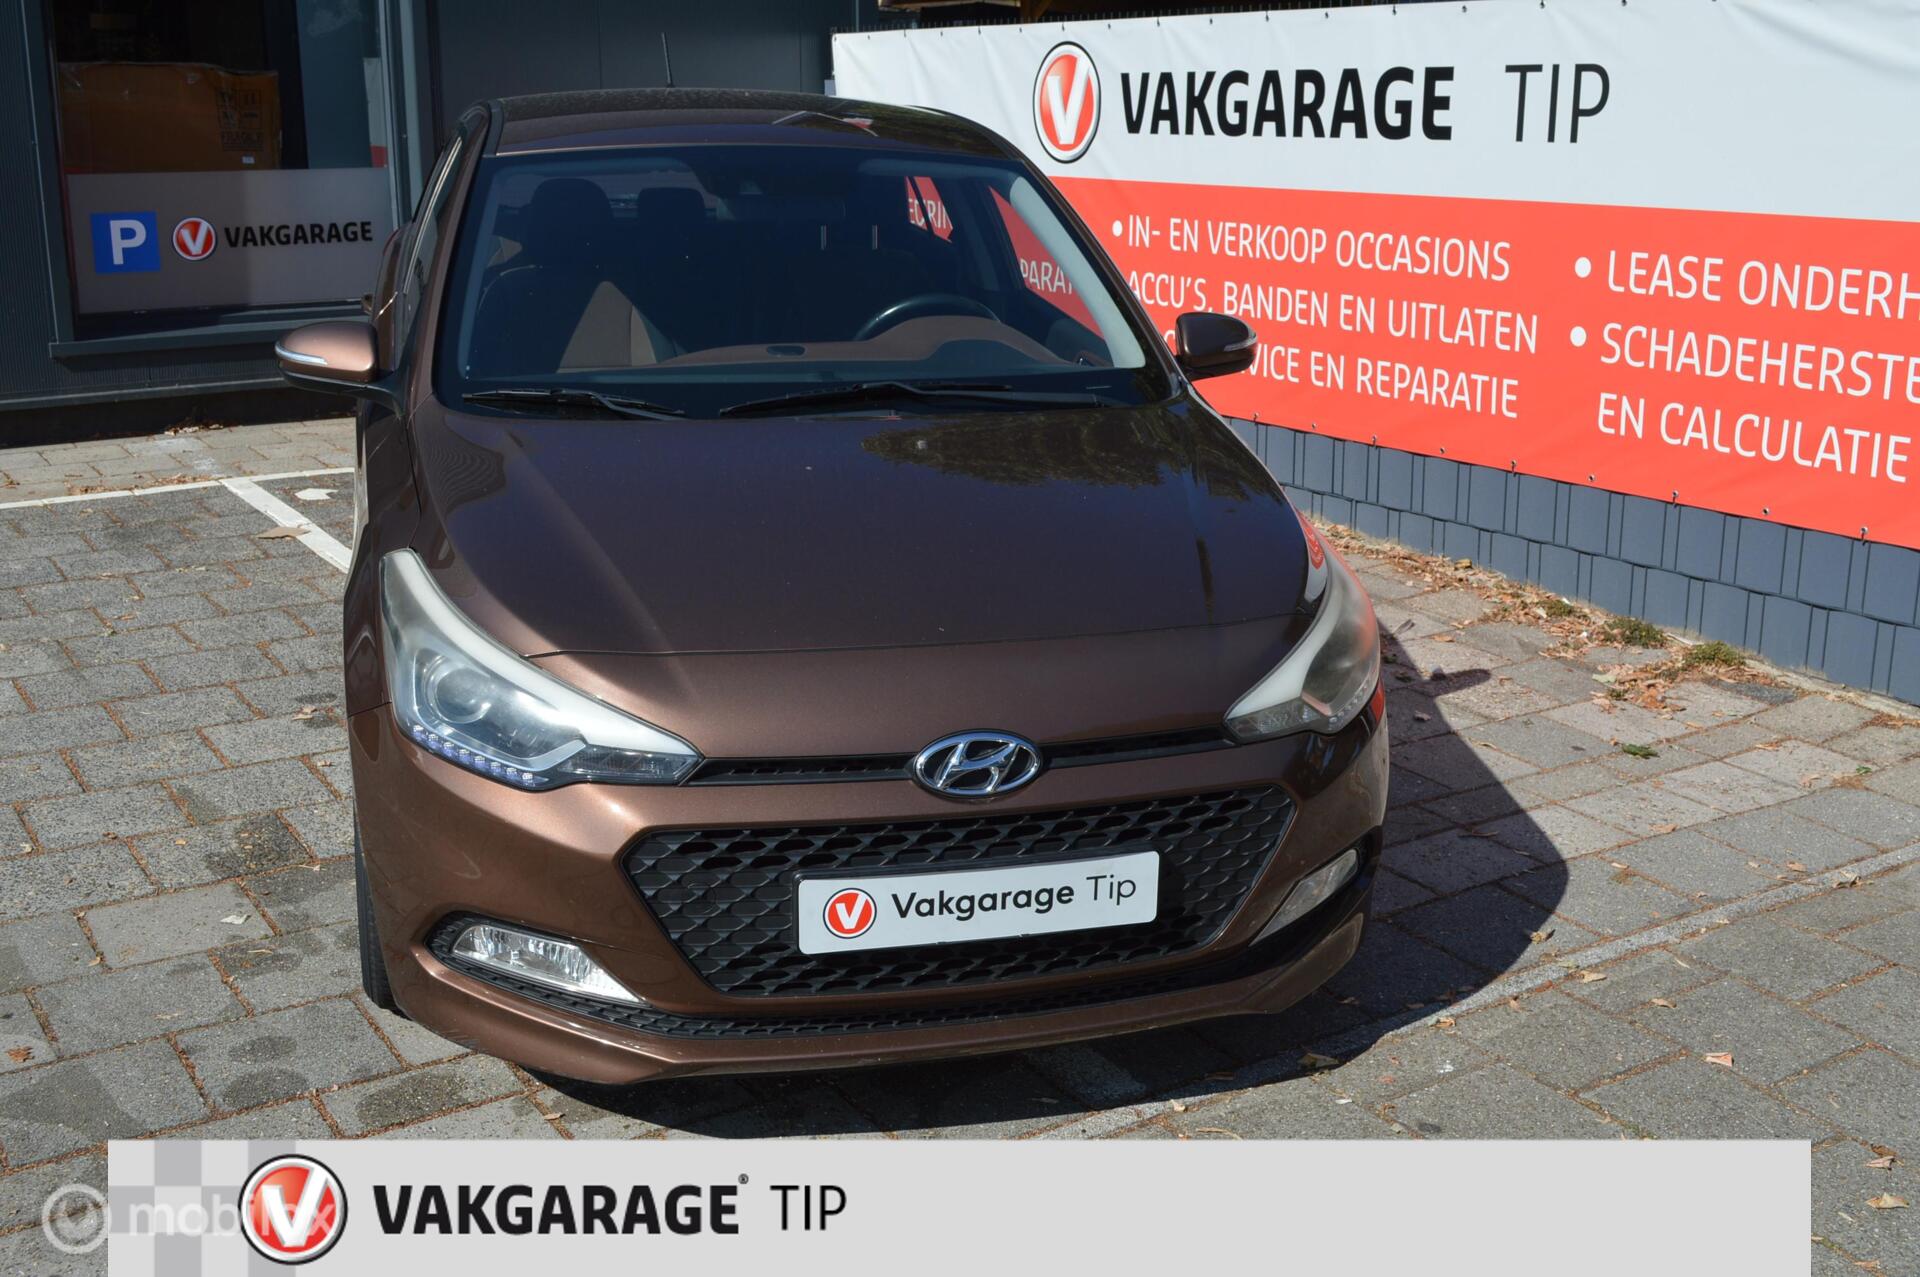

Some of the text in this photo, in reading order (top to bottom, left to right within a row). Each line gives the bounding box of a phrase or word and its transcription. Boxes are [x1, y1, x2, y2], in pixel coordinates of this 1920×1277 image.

[1120, 66, 1455, 141] VAKGARAGE
[1505, 63, 1610, 144] TIP
[109, 219, 147, 265] P
[224, 220, 374, 248] VAKGARAGE
[1128, 214, 1510, 282] IN- EN VERKOOP OCCASIONS
[1608, 250, 1723, 302] LEASE
[1223, 281, 1328, 328] BANDEN
[1339, 294, 1375, 334] EN
[1388, 299, 1538, 355] UITLATEN
[1310, 351, 1345, 391] EN
[1356, 357, 1519, 419] REPARATIE
[1597, 392, 1912, 484] EN CALCULATIE
[891, 886, 1075, 922] Vakgarage
[1086, 874, 1137, 906] Tip
